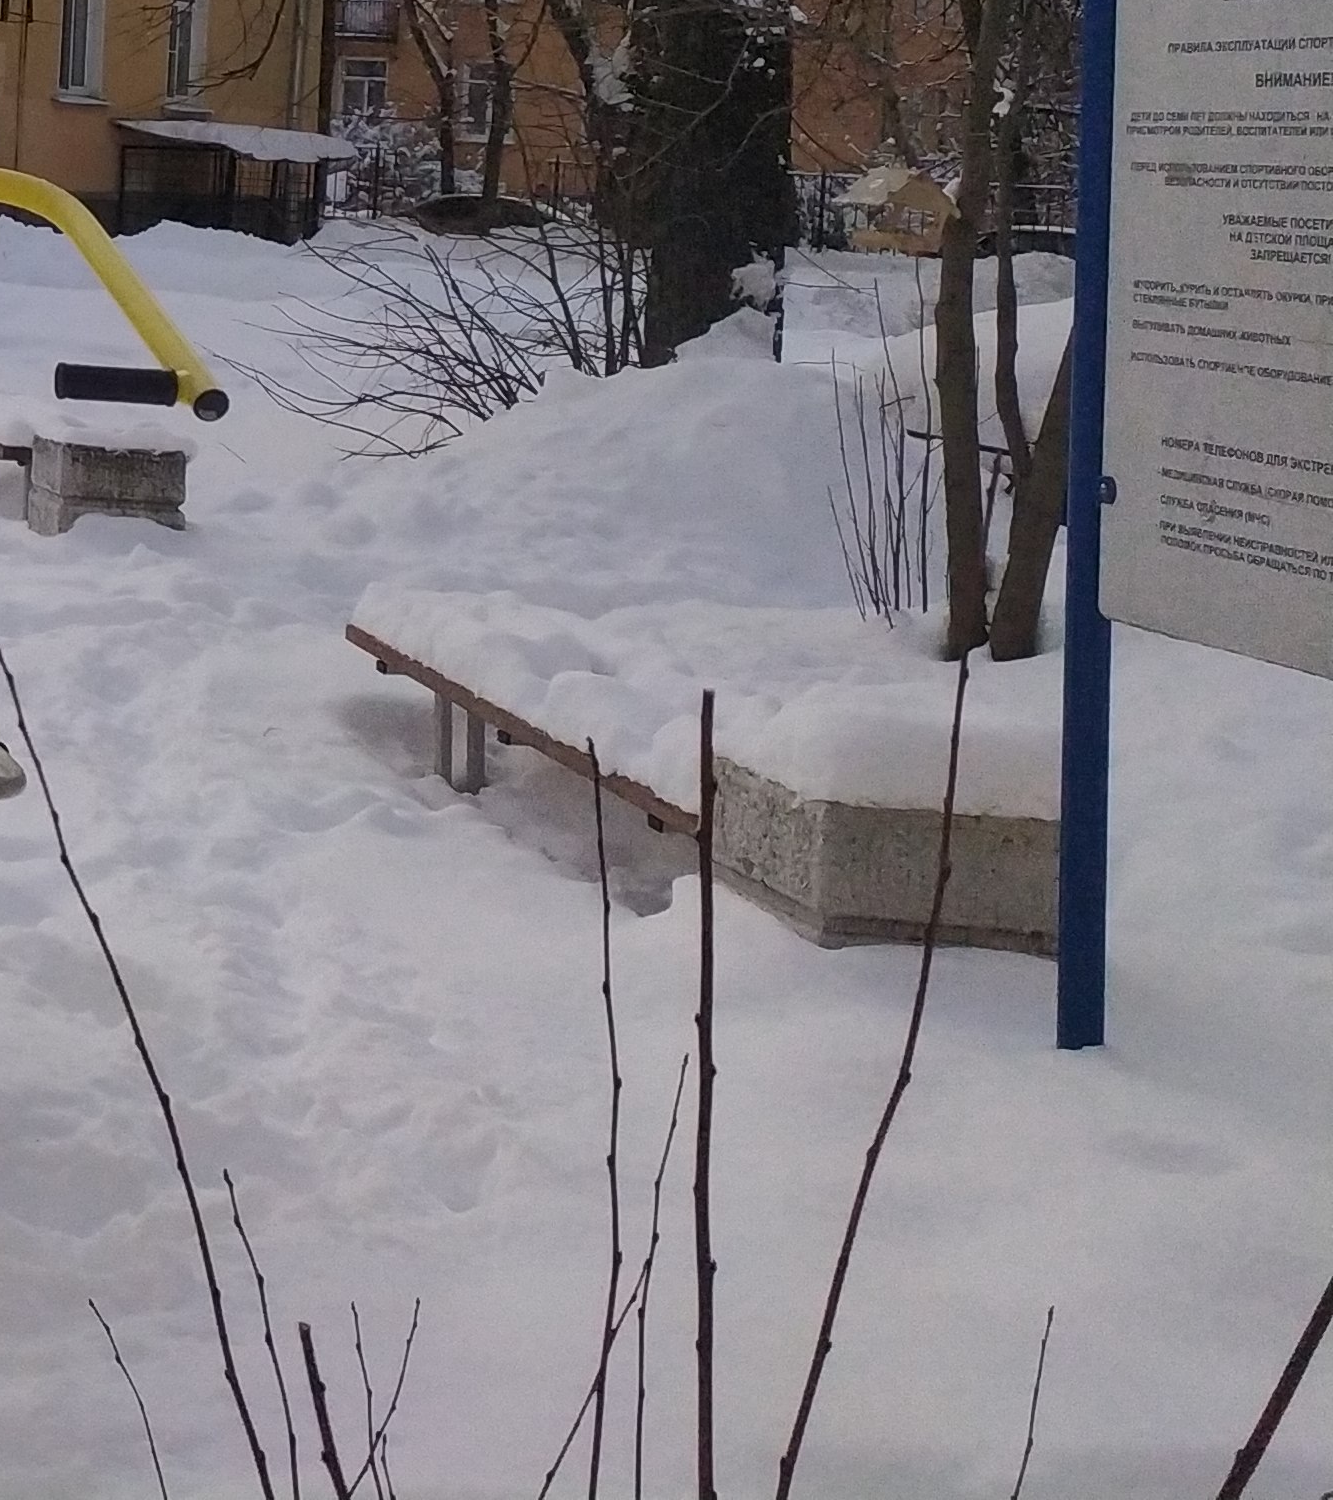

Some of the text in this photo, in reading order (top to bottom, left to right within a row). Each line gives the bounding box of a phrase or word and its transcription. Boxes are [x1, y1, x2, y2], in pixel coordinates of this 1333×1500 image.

[1168, 42, 1213, 54] ПРАВИЛА
[1215, 38, 1295, 53] ЭКСПЛУАТАЦИИ
[1130, 112, 1151, 122] ДЕТИ
[1152, 112, 1165, 122] ДО
[1249, 112, 1309, 123] НАХОДИТЬСЯ
[1240, 164, 1306, 176] СПОРТИВНОГО
[1222, 213, 1288, 228] УВАЖАЕМЫЕ
[1229, 232, 1243, 243] НА
[1245, 232, 1291, 245] ДЕТСКОЙ
[1250, 249, 1331, 265] ЗАПРЕЩАЕТСЯ!
[1132, 319, 1291, 346] ВЫГУЛИВАТЬ ДОМАШНИХ ЖИВОТНЫХ
[1130, 351, 1195, 368] ИСПОЛЬЗОВАТЬ
[1161, 436, 1333, 476] НОМЕРА ТЕЛЕФОНОВ ДЛЯ ЭКСТРЕ
[1226, 479, 1262, 496] СЛУЖБА
[1247, 554, 1311, 576] ОБРАЩАТЬСЯ
